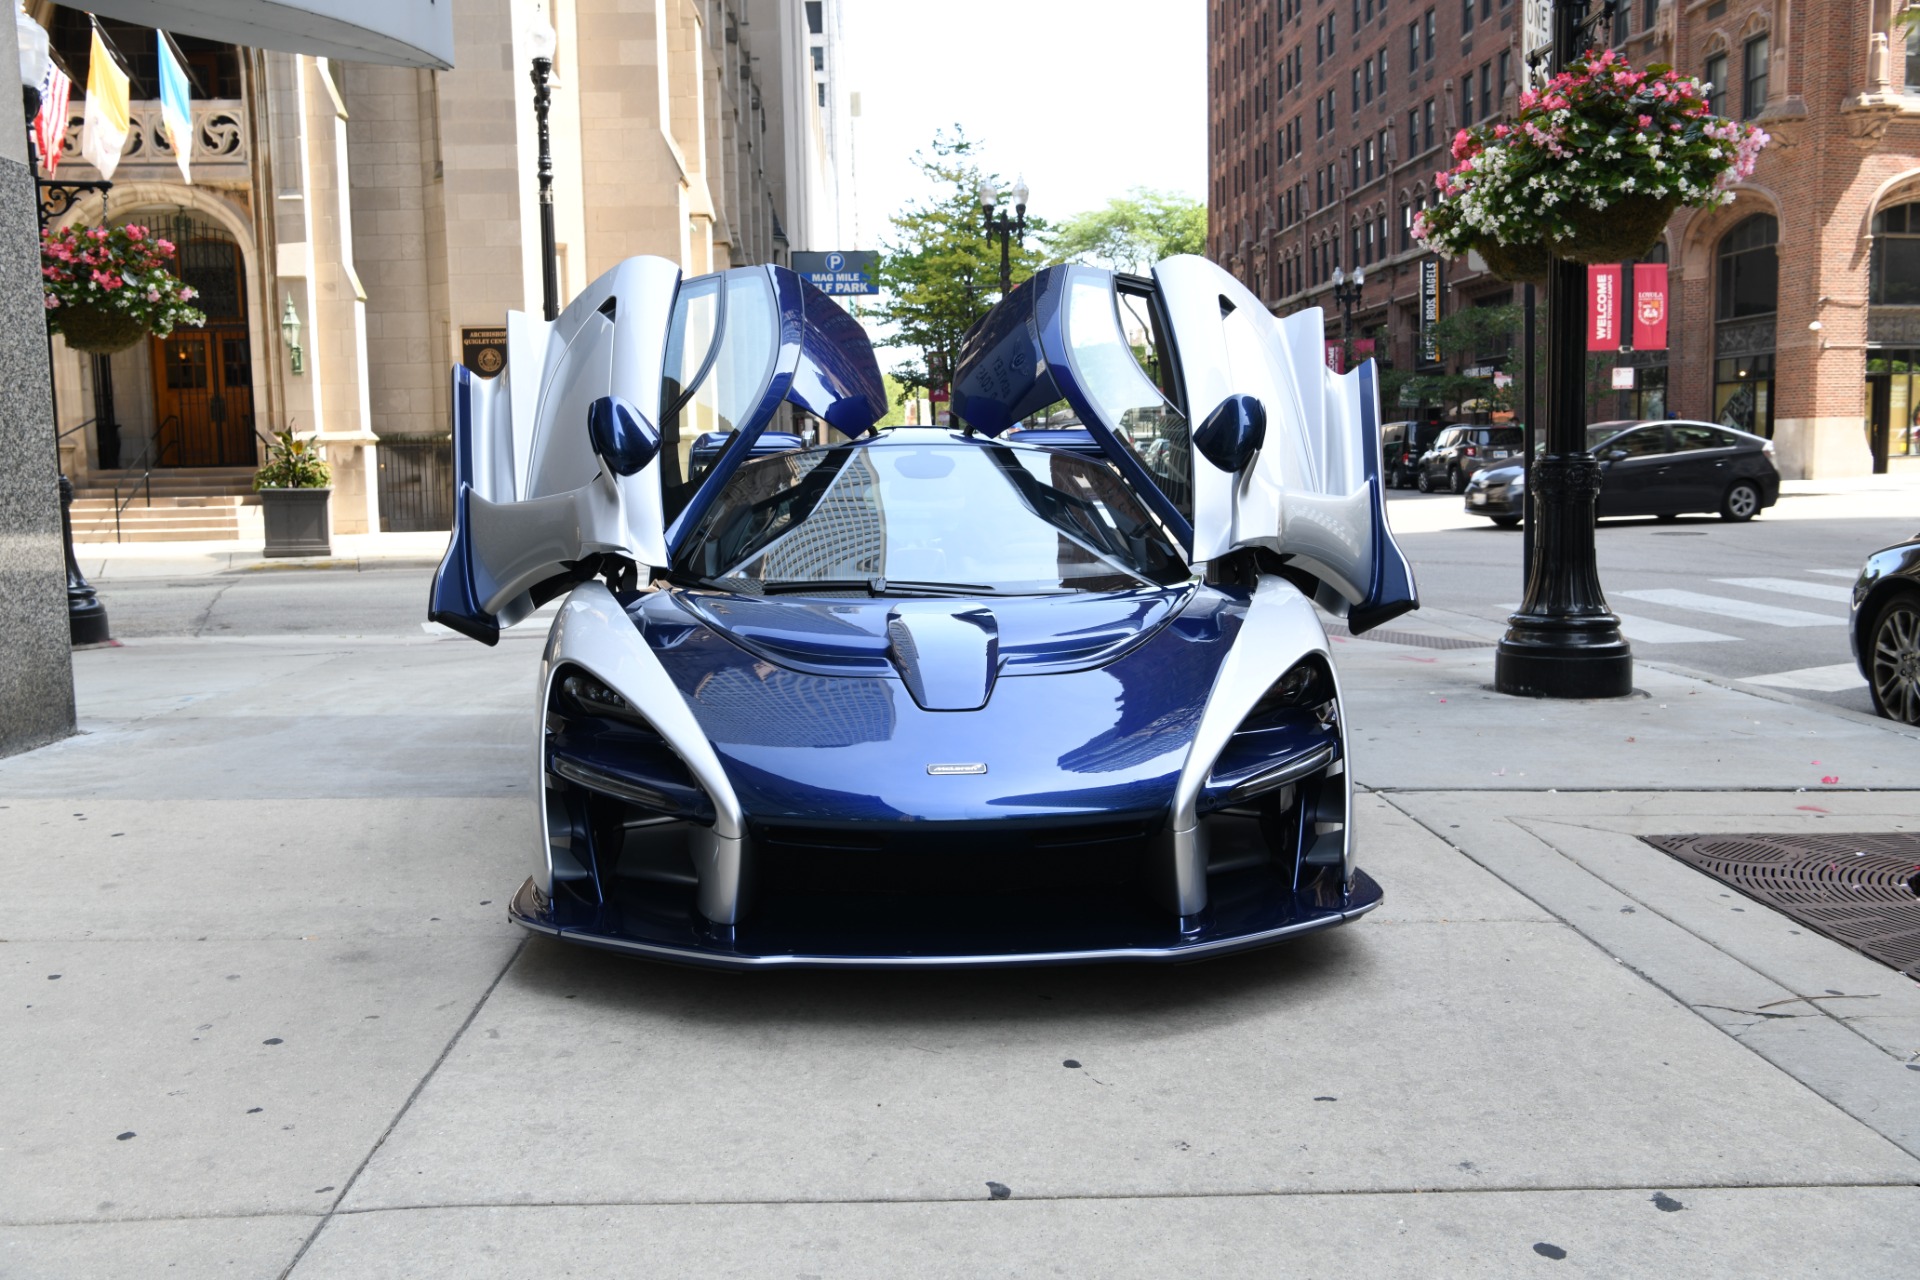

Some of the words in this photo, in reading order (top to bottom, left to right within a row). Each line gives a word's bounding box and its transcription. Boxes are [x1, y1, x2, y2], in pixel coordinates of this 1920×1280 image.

[1527, 0, 1547, 32] ONE
[812, 273, 834, 282] MAG
[836, 273, 860, 282] MILE
[835, 282, 868, 293] PARK
[1426, 262, 1436, 295] BAGELS
[1596, 274, 1607, 340] WELCOME
